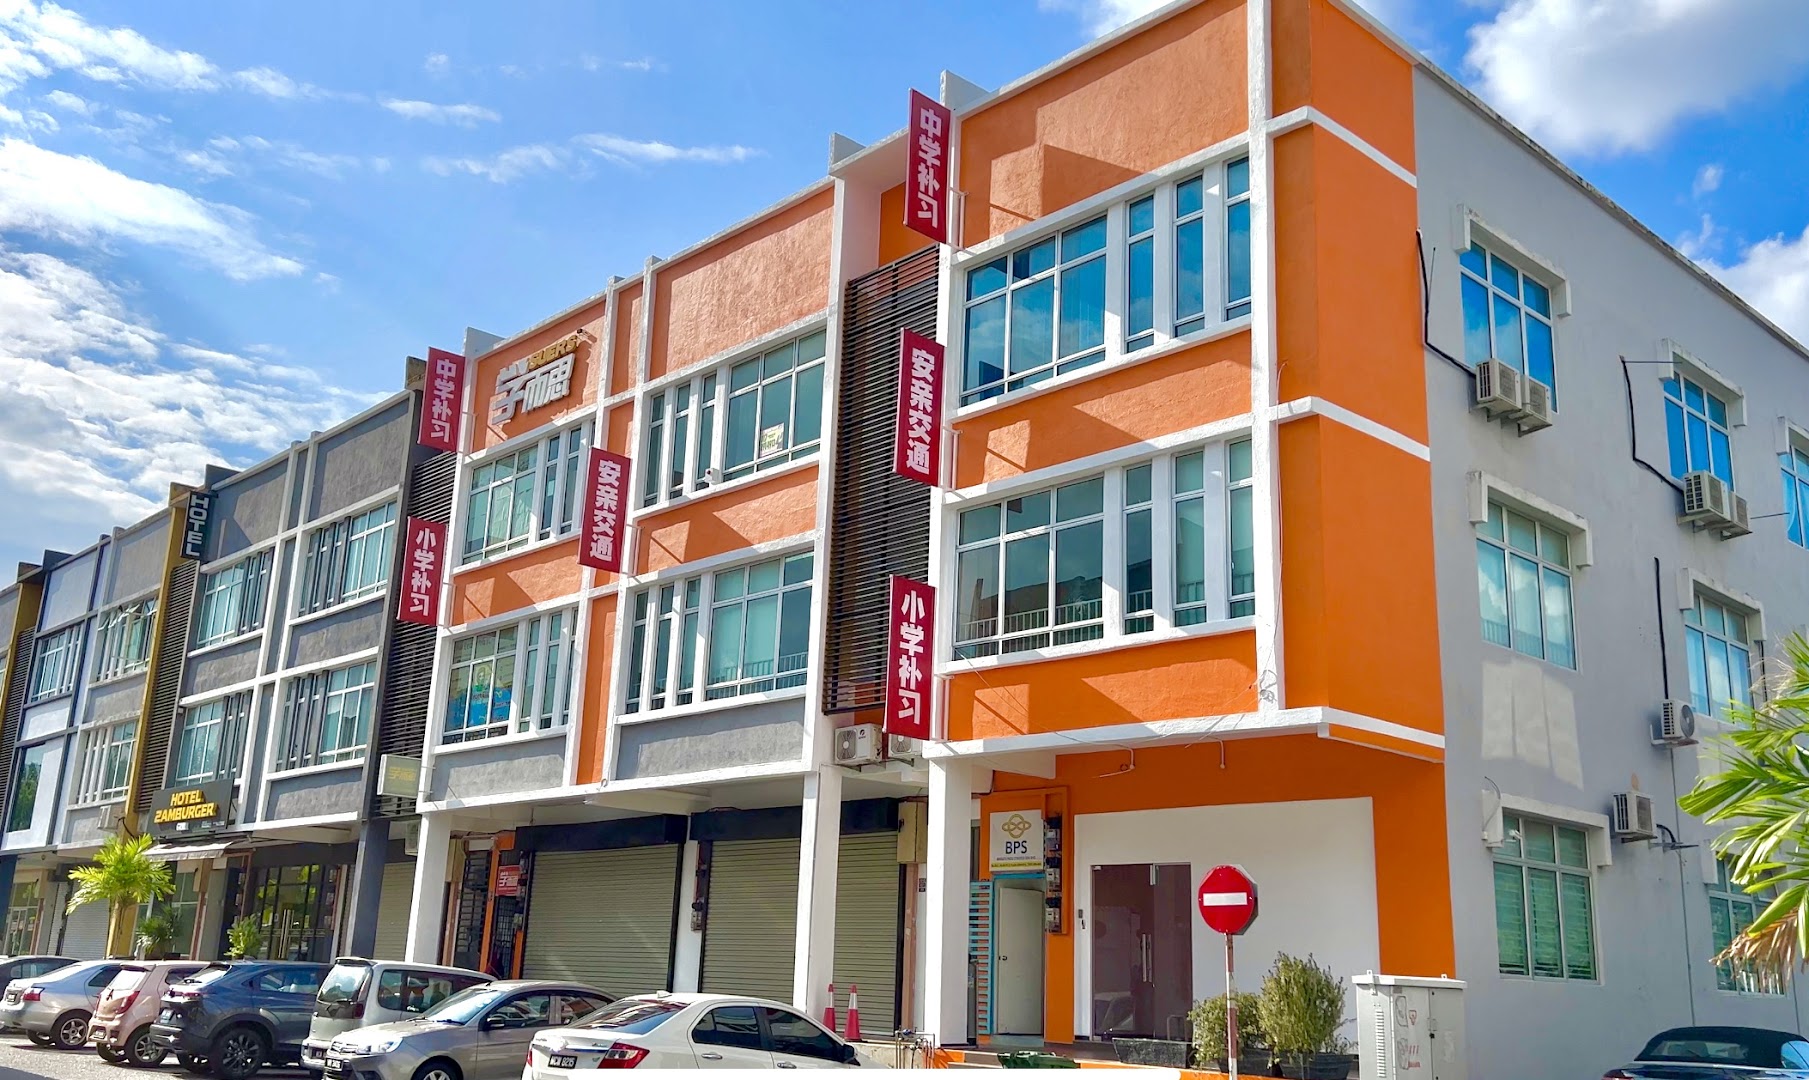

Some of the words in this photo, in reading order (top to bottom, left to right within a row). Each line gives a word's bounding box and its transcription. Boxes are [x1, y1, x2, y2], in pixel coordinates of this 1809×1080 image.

[917, 107, 942, 229] 中学补习
[430, 358, 457, 443] 中学补习
[906, 347, 935, 475] 安亲交通
[185, 494, 210, 557] HOTEL
[589, 459, 622, 562] 安亲交通
[409, 527, 437, 617] 小学补习
[898, 590, 926, 725] 小学补习
[170, 789, 204, 806] HOTEL
[1005, 840, 1028, 855] BPS
